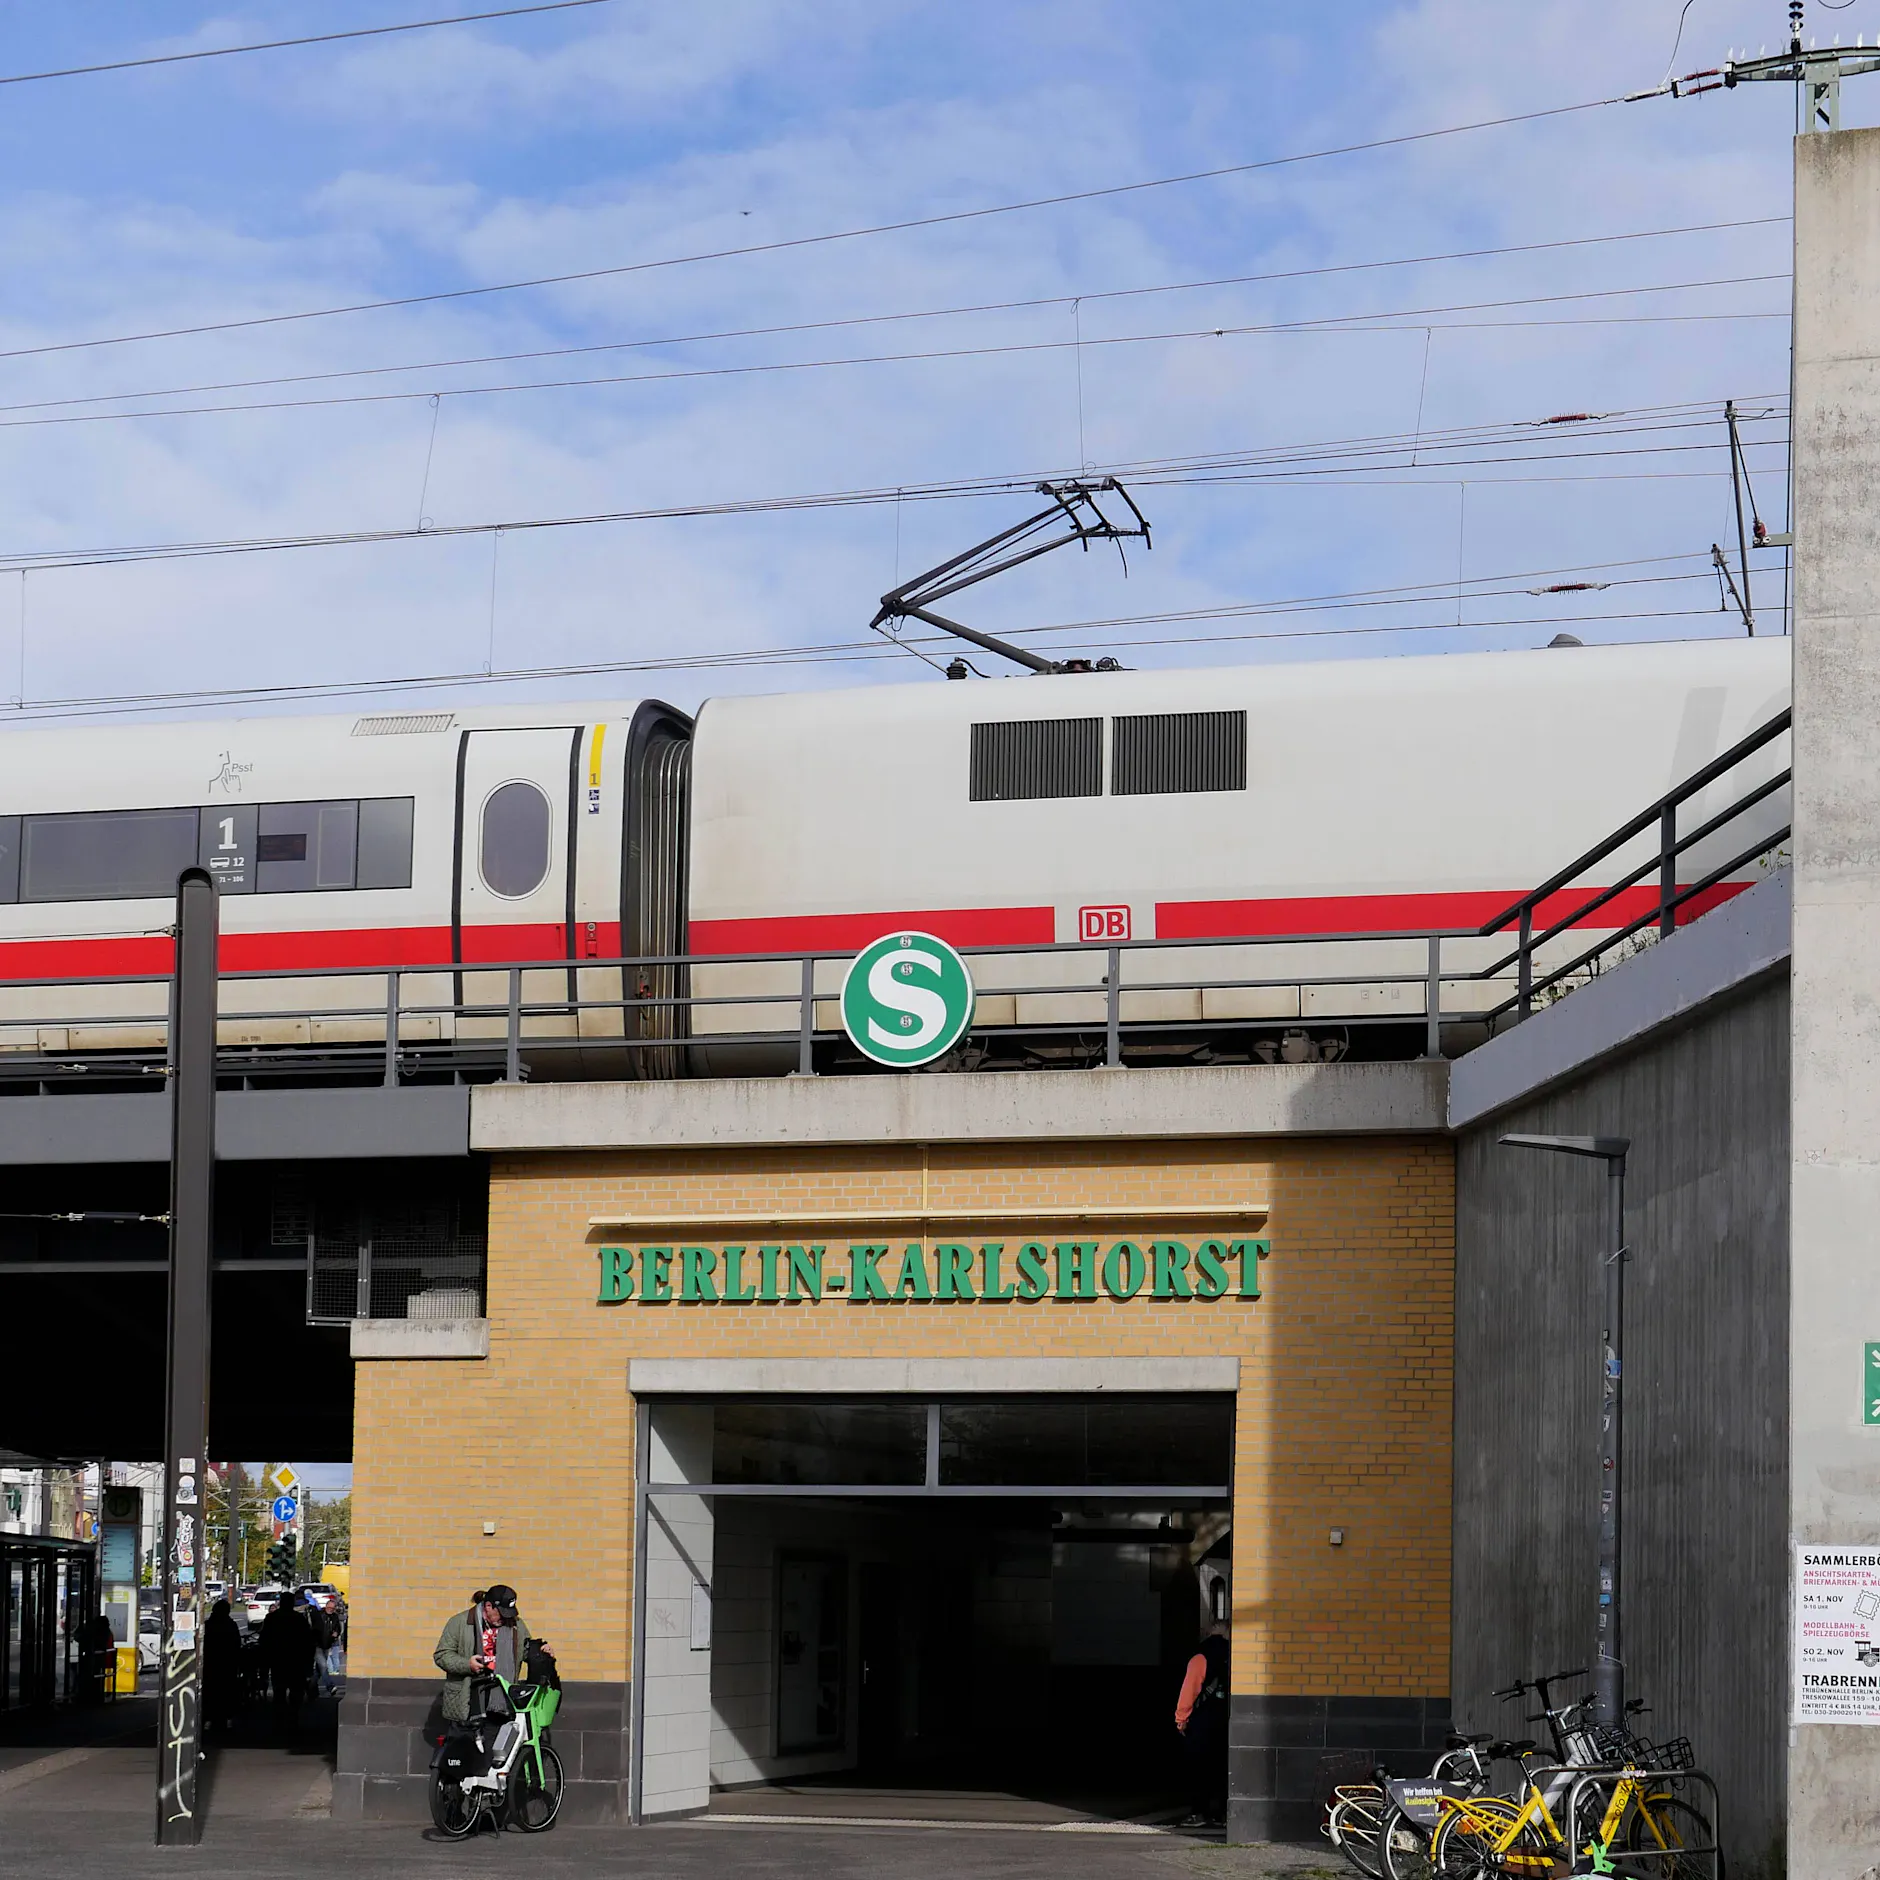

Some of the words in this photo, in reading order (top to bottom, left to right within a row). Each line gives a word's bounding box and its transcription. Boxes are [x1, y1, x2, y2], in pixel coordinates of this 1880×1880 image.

[231, 763, 254, 773] Psst
[590, 773, 598, 785] 1
[218, 817, 238, 850] 1
[232, 857, 245, 867] 12
[1085, 911, 1126, 938] DB
[868, 949, 948, 1050] S
[596, 1238, 1271, 1304] BERLIN-KARLSHORST
[1803, 1570, 1877, 1579] ANSICHTSKARTEN-,
[1803, 1629, 1870, 1638] SPIELZEUGBÖRSE
[1816, 1648, 1825, 1656] 2.
[1827, 1648, 1845, 1656] NOV
[1802, 1674, 1880, 1687] TRABRENN
[1403, 1787, 1414, 1796] Wir
[1414, 1787, 1433, 1796] helfen
[1433, 1787, 1443, 1796] bei
[1615, 1799, 1625, 1816] ofo
